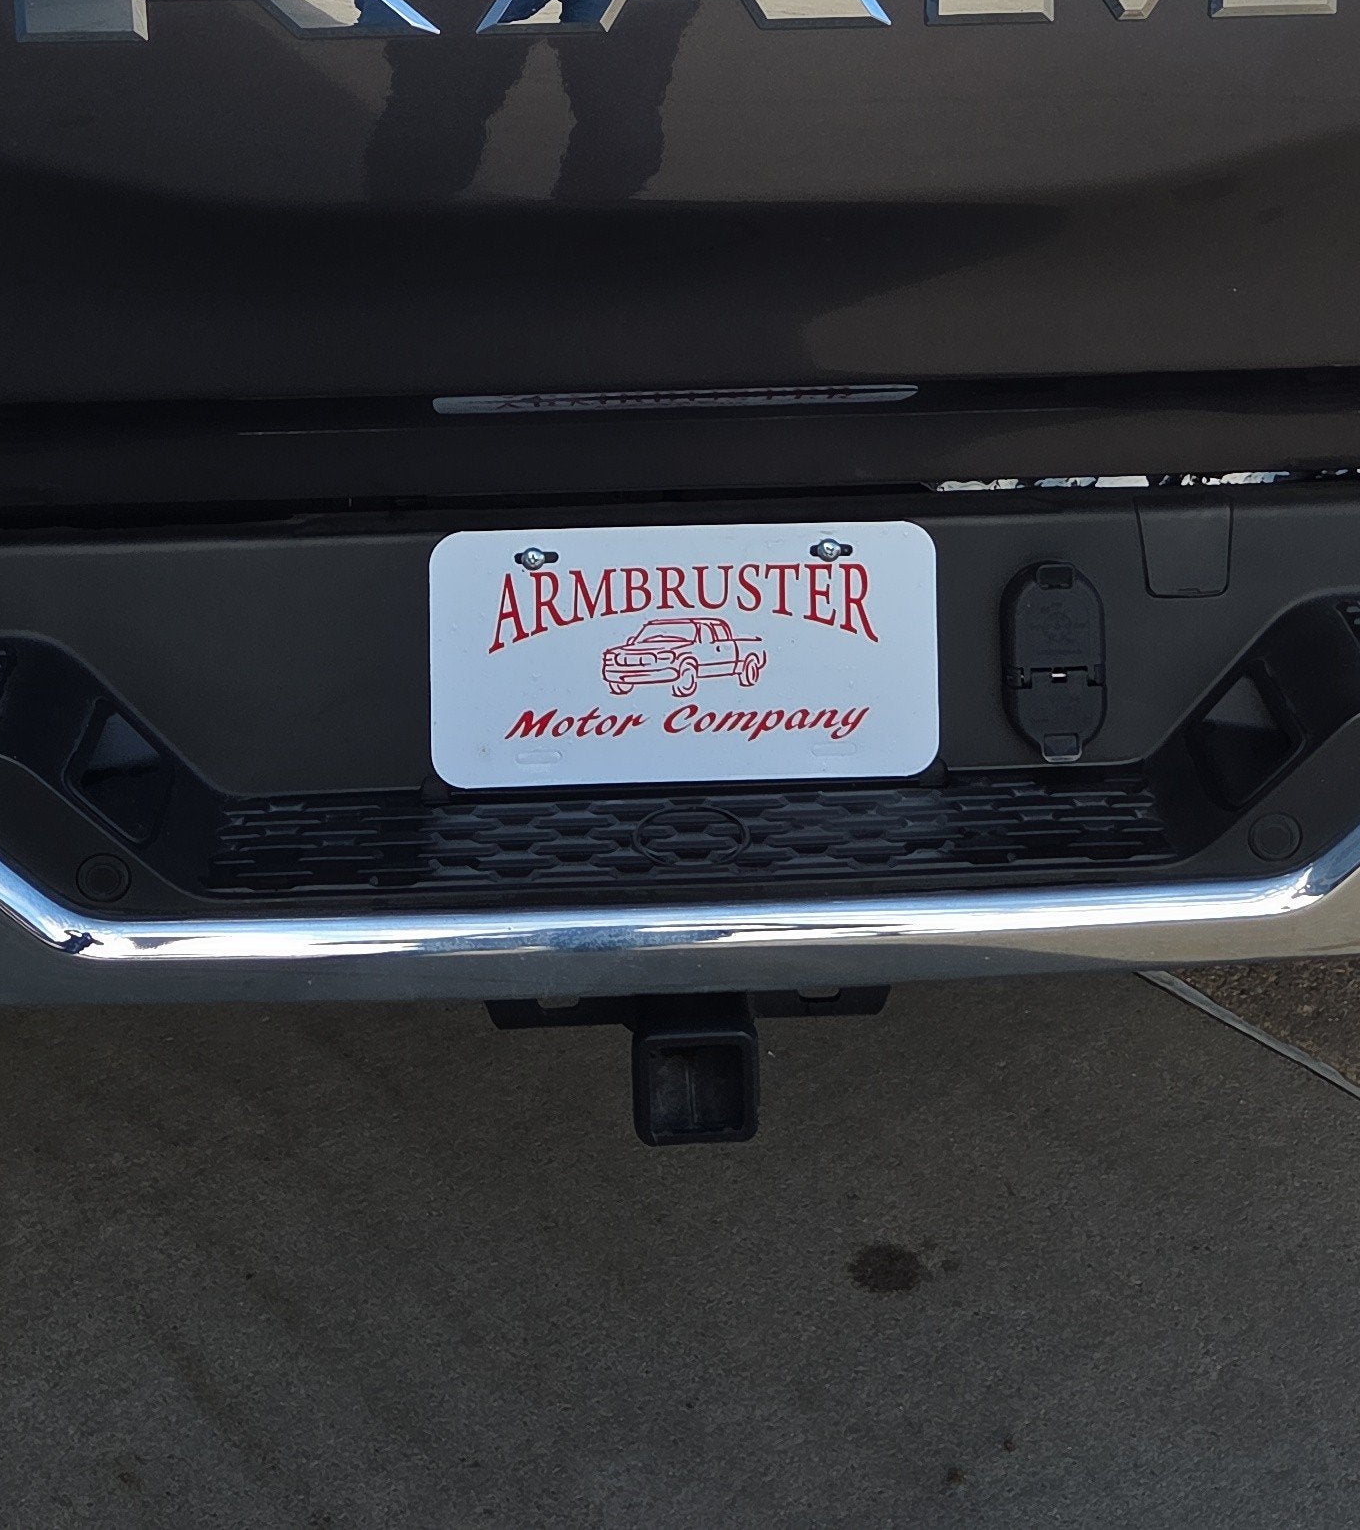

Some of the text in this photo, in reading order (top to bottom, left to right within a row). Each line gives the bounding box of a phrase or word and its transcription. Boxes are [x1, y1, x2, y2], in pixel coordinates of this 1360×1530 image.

[488, 561, 879, 654] ARMBRUSTER
[503, 703, 871, 743] Motor Company
